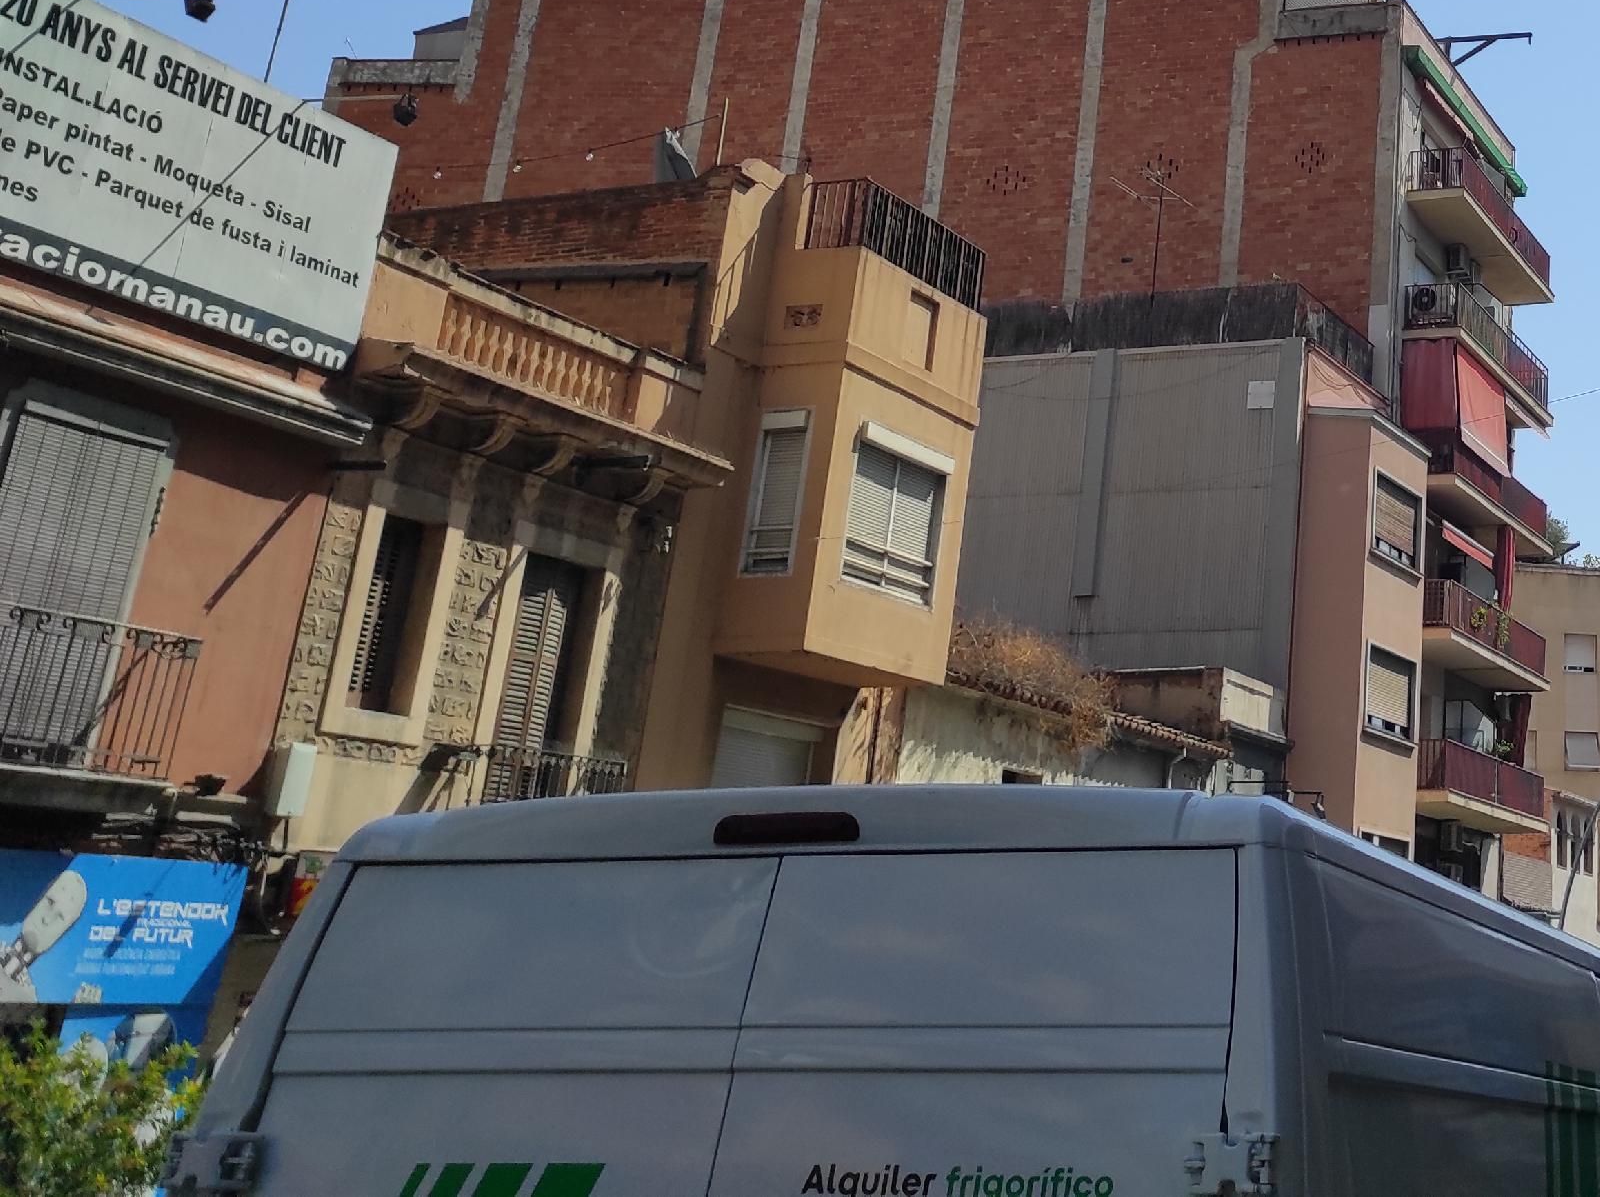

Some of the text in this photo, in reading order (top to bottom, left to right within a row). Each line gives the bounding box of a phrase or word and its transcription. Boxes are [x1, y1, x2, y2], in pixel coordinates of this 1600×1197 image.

[39, 2, 116, 62] ANYS
[117, 38, 148, 80] AL
[153, 54, 235, 118] SERVEI
[235, 91, 272, 137] DEL
[277, 112, 346, 168] CLIENT
[0, 88, 60, 130] aper
[64, 122, 134, 162] pintat
[153, 154, 244, 207] Moqueta
[262, 199, 312, 234] Sisal
[0, 128, 16, 153] e
[24, 138, 75, 175] PVC
[95, 168, 183, 218] Parquet
[190, 207, 215, 231] de
[221, 218, 272, 253] fusta
[277, 239, 285, 258] i
[290, 244, 360, 289] laminat
[0, 229, 347, 371] aciomanau.com
[132, 926, 194, 949] FUTUR
[801, 1163, 1114, 1197] Alquiler frigorífico
